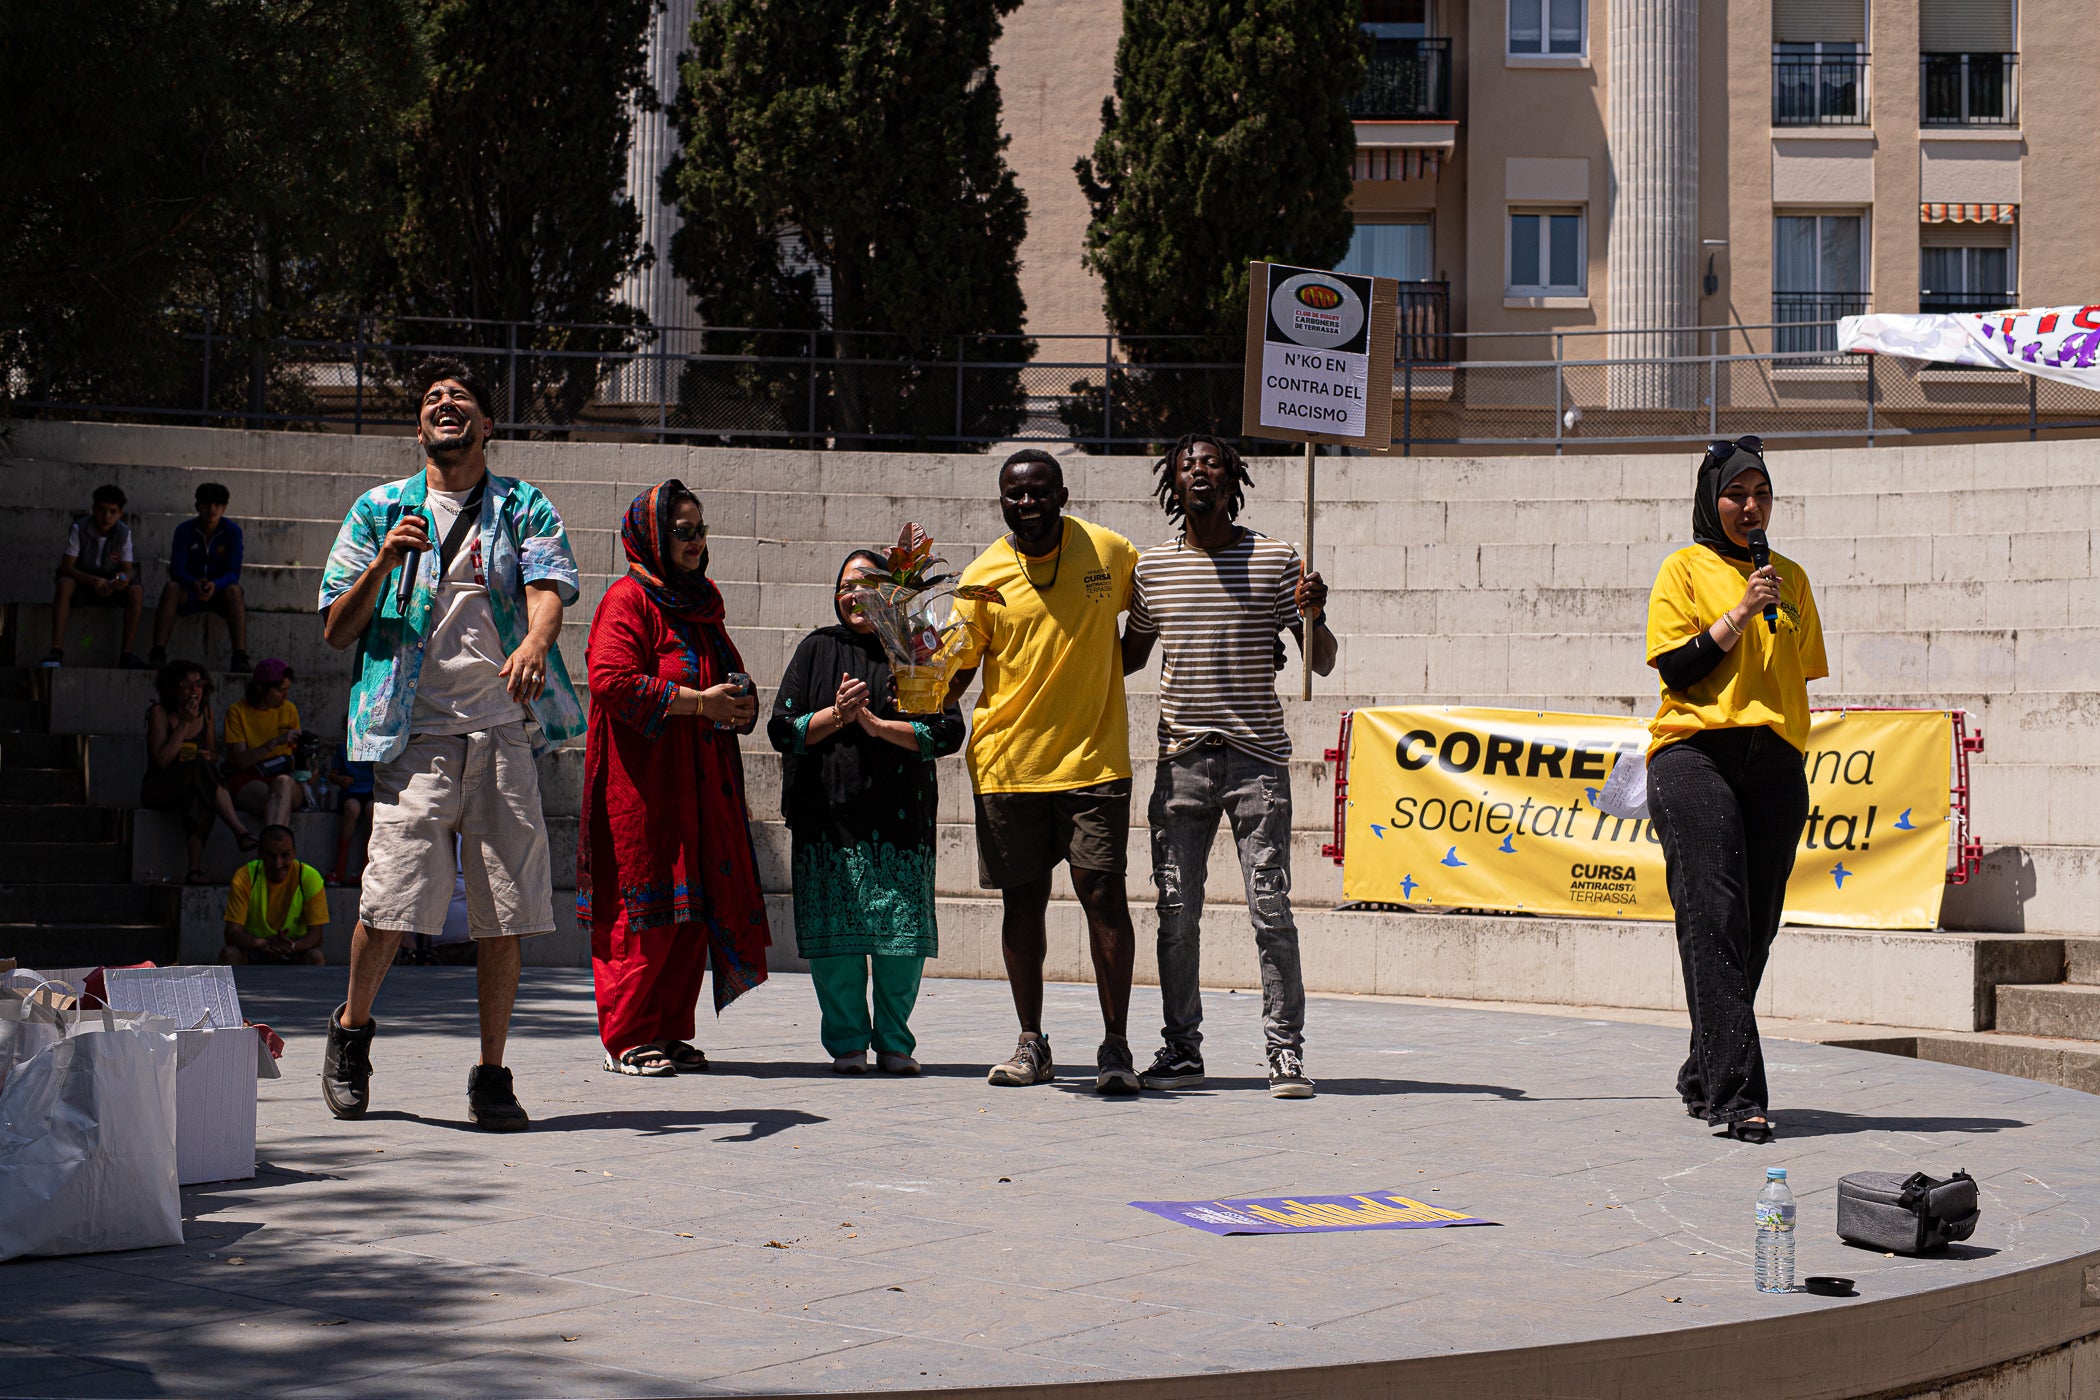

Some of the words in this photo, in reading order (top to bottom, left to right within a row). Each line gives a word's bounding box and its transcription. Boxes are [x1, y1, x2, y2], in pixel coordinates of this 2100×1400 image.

[1295, 316, 1340, 328] CARBONERS
[1320, 313, 1340, 321] RUGBY
[1304, 324, 1339, 334] TERRASSA
[1326, 358, 1346, 373] EN
[1267, 375, 1329, 396] CONTRA
[1333, 384, 1361, 399] DEL
[1278, 401, 1347, 422] RACISMO
[1083, 573, 1111, 583] CURSA
[1390, 790, 1583, 838] societat
[1806, 805, 1877, 851] ta!
[1571, 863, 1636, 881] CURSA
[1570, 881, 1636, 892] ANTIRACISTA
[1569, 890, 1637, 905] TERRASSA
